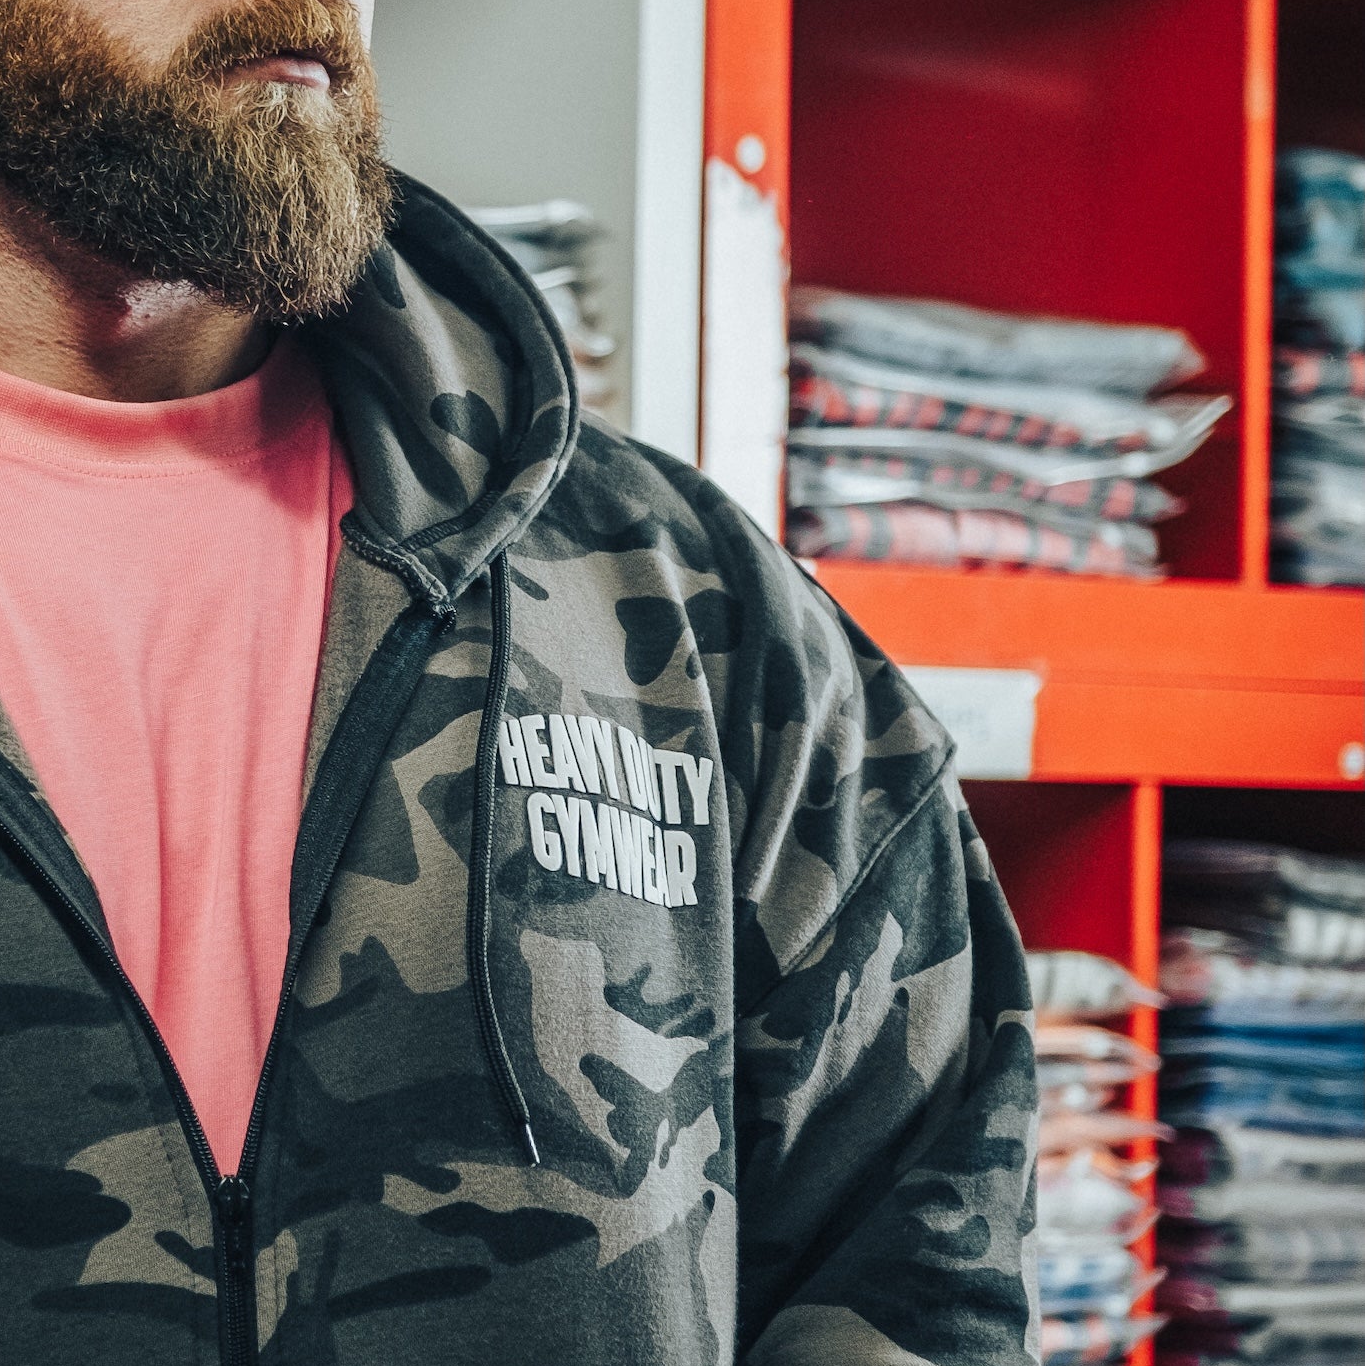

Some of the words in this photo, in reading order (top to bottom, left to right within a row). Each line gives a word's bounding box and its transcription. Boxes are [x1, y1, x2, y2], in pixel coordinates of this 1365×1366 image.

[498, 714, 620, 800] HEAVY
[617, 725, 714, 826] DUTY
[527, 792, 698, 908] GYMWEAR
